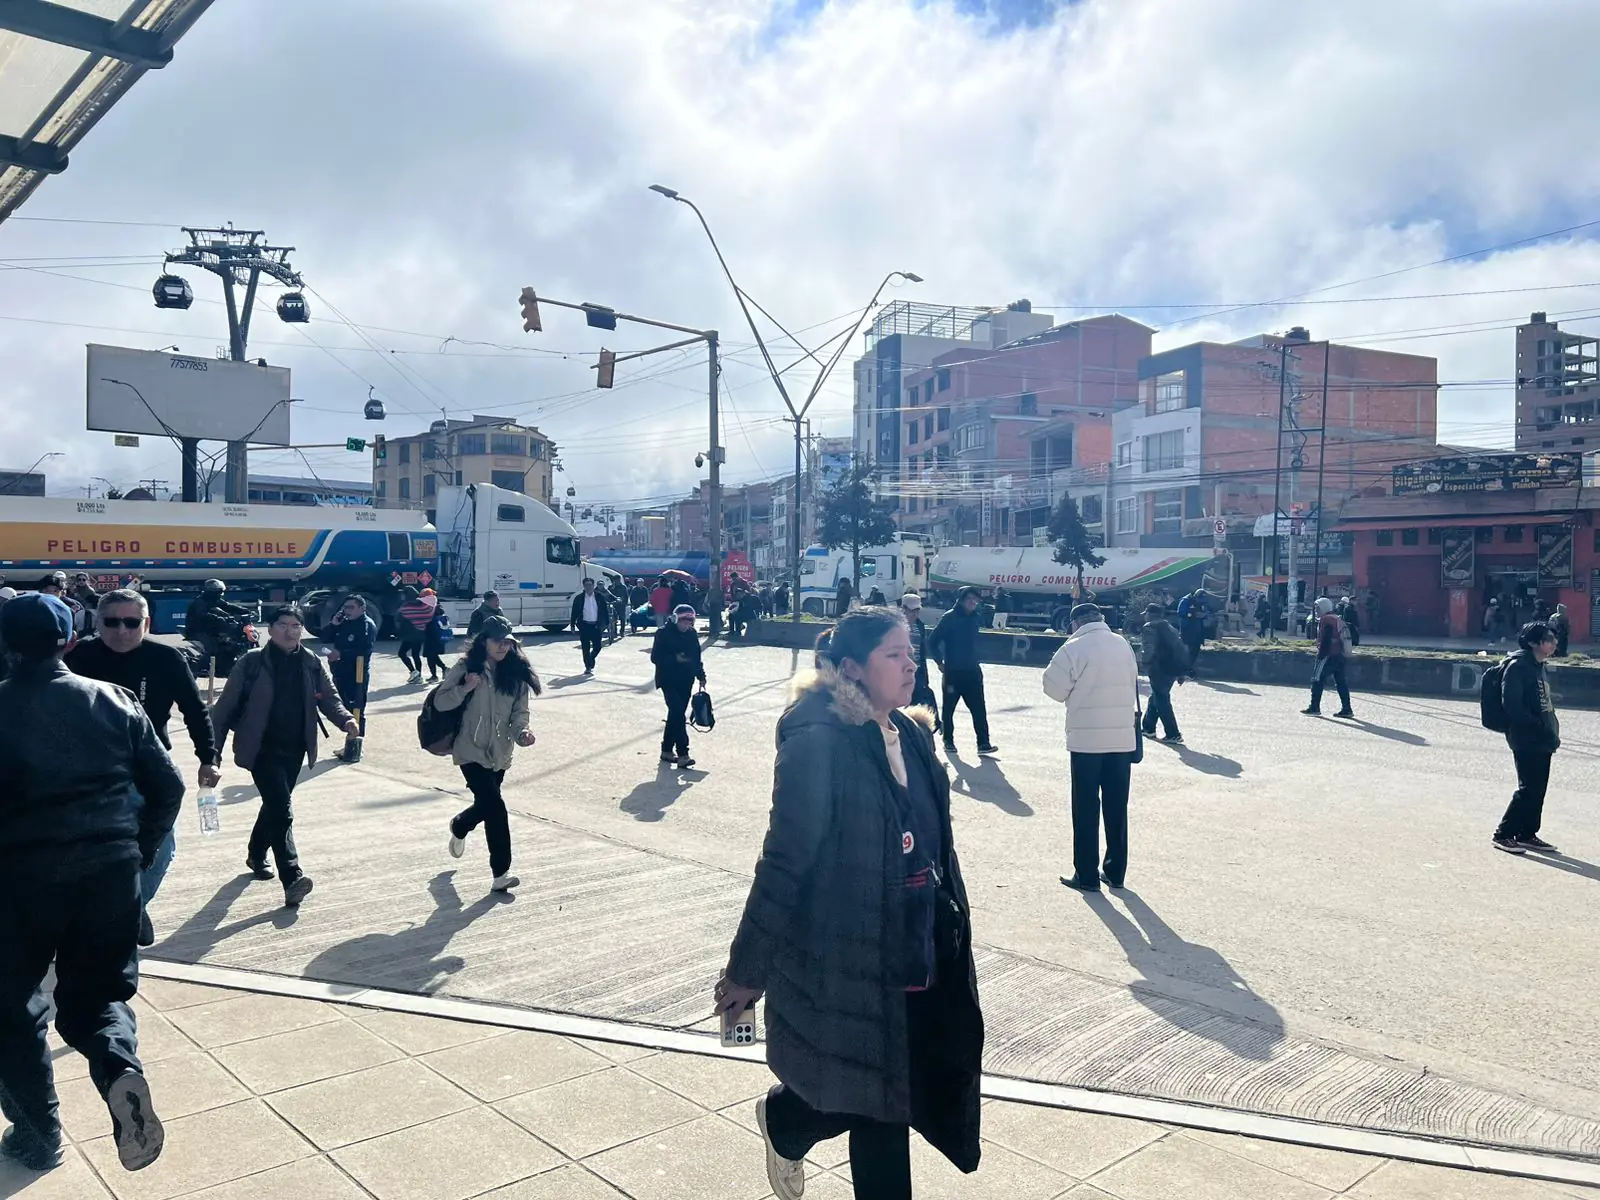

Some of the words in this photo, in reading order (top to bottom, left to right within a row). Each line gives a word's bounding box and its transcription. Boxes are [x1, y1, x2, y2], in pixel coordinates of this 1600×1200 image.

[170, 358, 207, 371] 77577853
[47, 540, 140, 553] PELIGRO
[165, 541, 297, 554] COMBUSTIBLE
[989, 574, 1031, 584] PELIGRO
[1041, 575, 1117, 586] COMBUTIBLE
